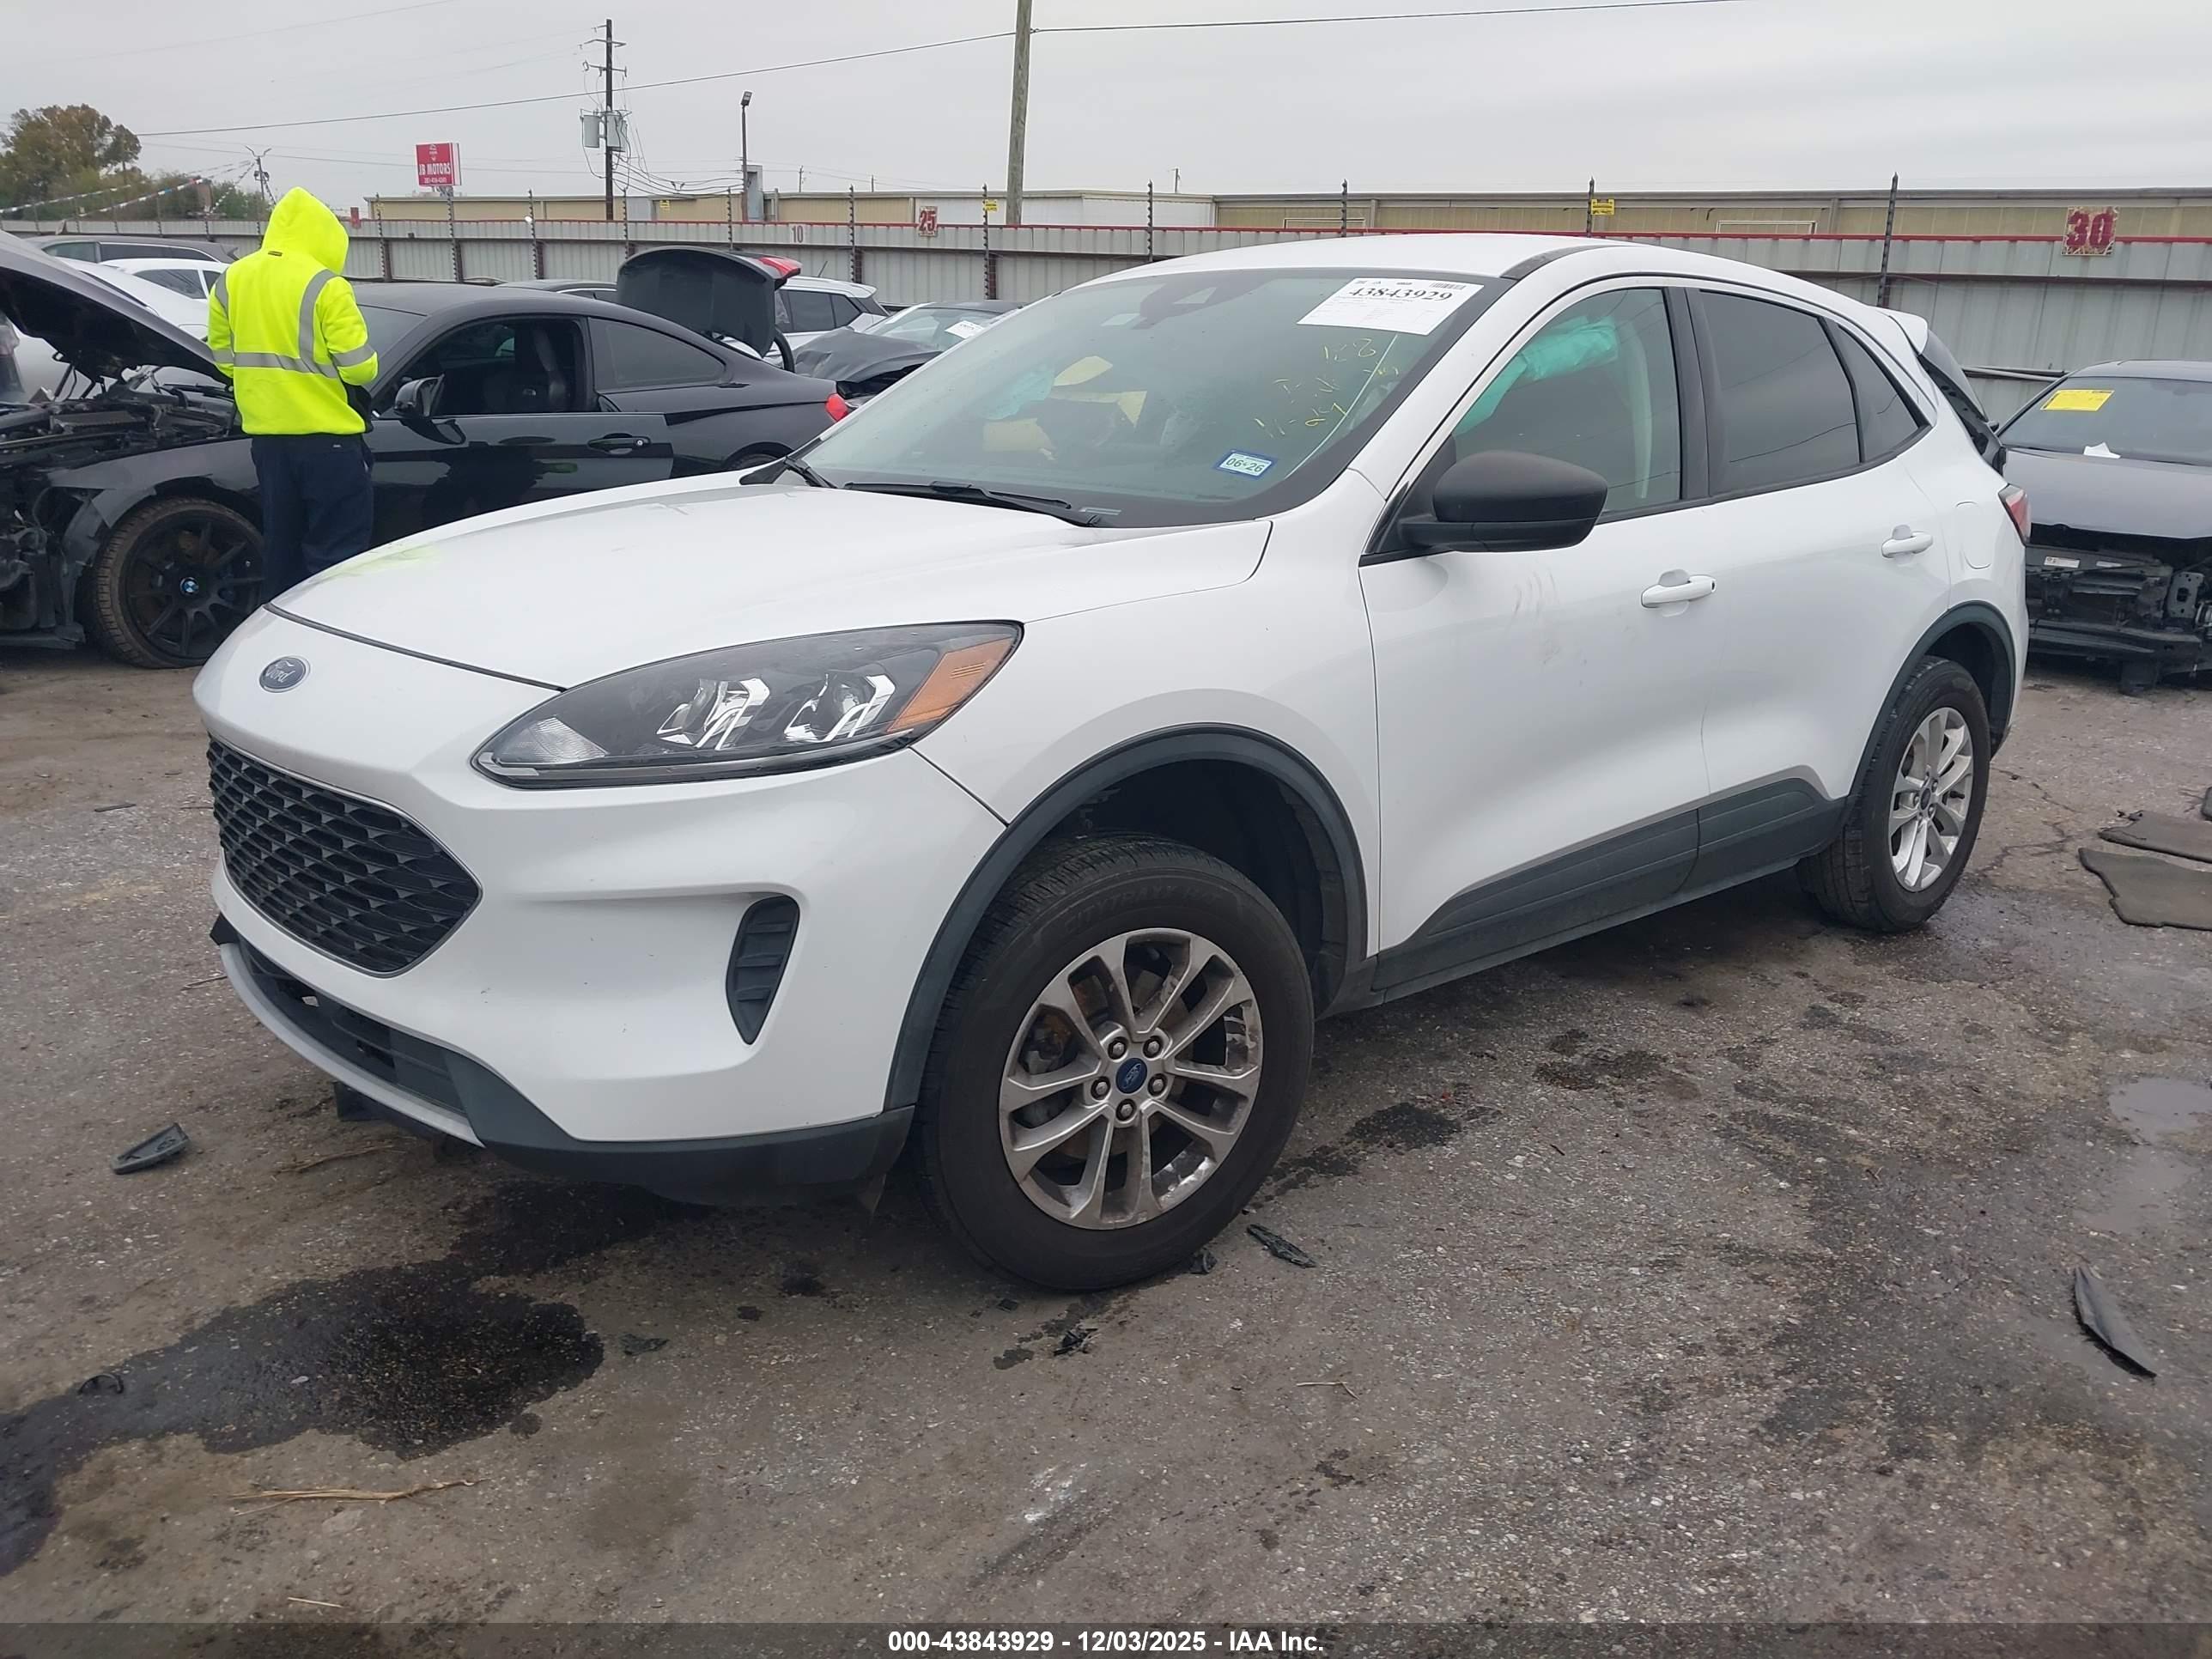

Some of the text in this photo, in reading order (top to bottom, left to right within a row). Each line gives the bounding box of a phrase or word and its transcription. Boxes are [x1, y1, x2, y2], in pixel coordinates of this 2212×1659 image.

[427, 162, 452, 175] MOTORS
[919, 210, 937, 232] 25
[2066, 211, 2113, 249] 30
[791, 225, 804, 243] 10
[1346, 286, 1454, 301] 43843929
[264, 659, 297, 684] Ford
